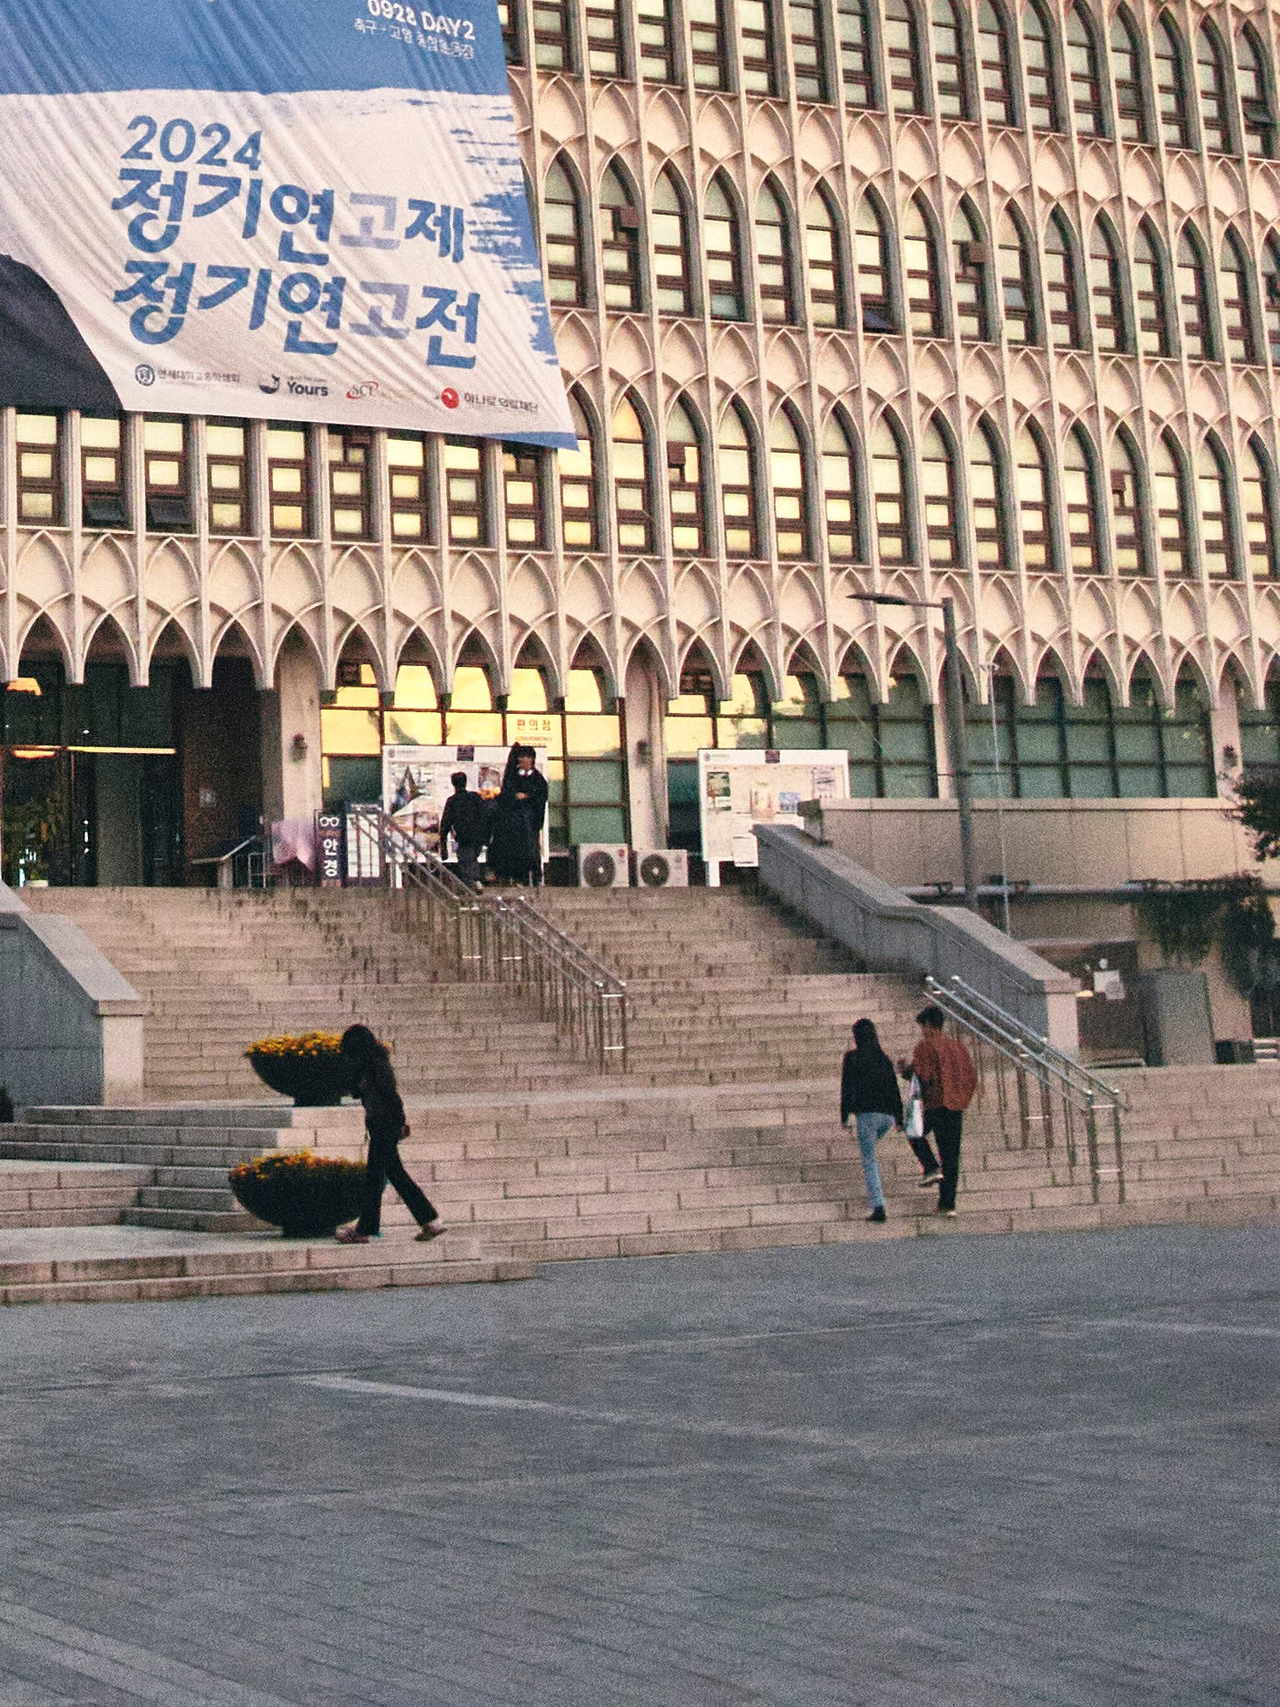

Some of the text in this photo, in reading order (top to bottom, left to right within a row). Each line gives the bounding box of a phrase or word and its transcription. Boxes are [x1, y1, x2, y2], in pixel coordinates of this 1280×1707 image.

[120, 115, 263, 171] 2024
[111, 167, 465, 266] 정기연고제
[112, 260, 481, 370] 정기연고전
[287, 381, 329, 397] Yours
[322, 838, 340, 877] 안경
